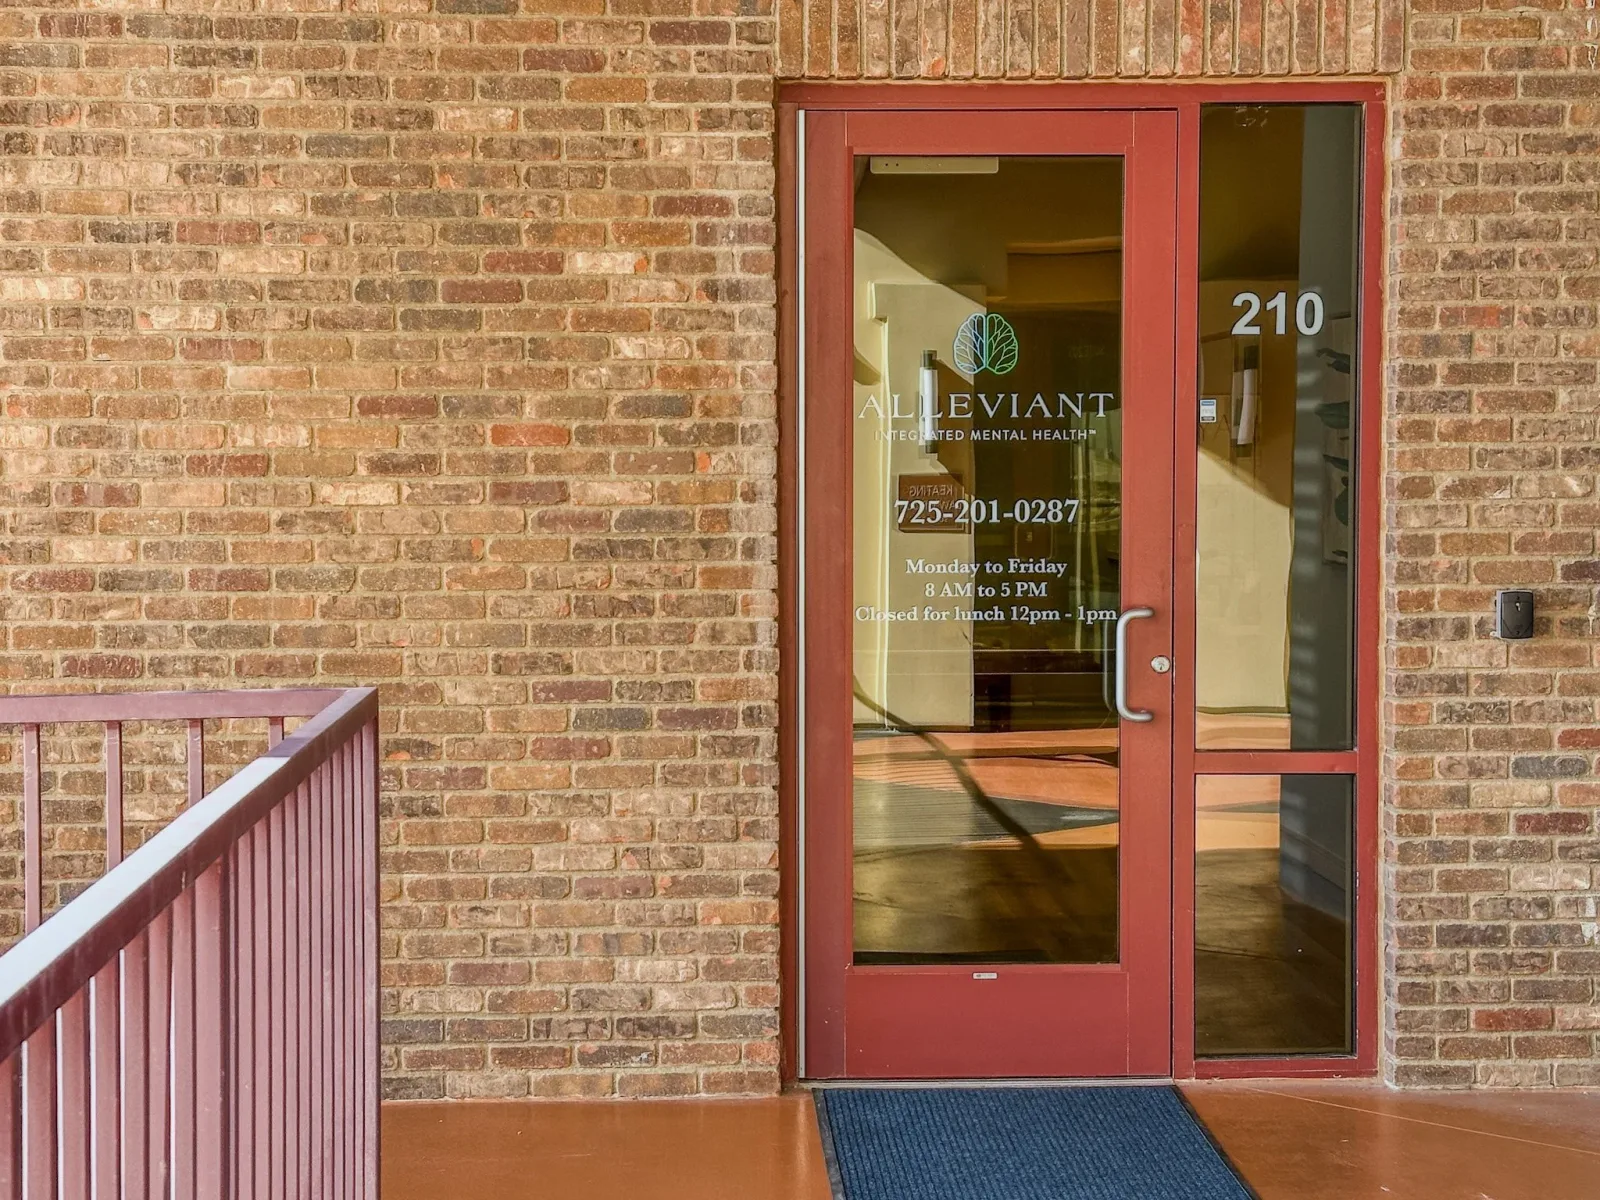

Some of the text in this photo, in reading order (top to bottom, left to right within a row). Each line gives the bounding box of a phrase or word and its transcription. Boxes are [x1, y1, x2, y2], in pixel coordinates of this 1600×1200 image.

[1231, 291, 1325, 336] 210
[857, 393, 1115, 419] ALLEVIANT
[874, 430, 964, 441] INTEGRATED
[970, 430, 1027, 441] MENTAL
[893, 499, 1080, 525] 725-201-0287
[905, 558, 1068, 578] Monday to Friday
[924, 582, 1048, 598] 8 AM to 5 PM
[855, 606, 918, 622] Closed
[923, 606, 950, 622] for
[953, 606, 1007, 622] lunch
[1010, 606, 1061, 625] 12pm
[1077, 606, 1118, 625] 1pm
